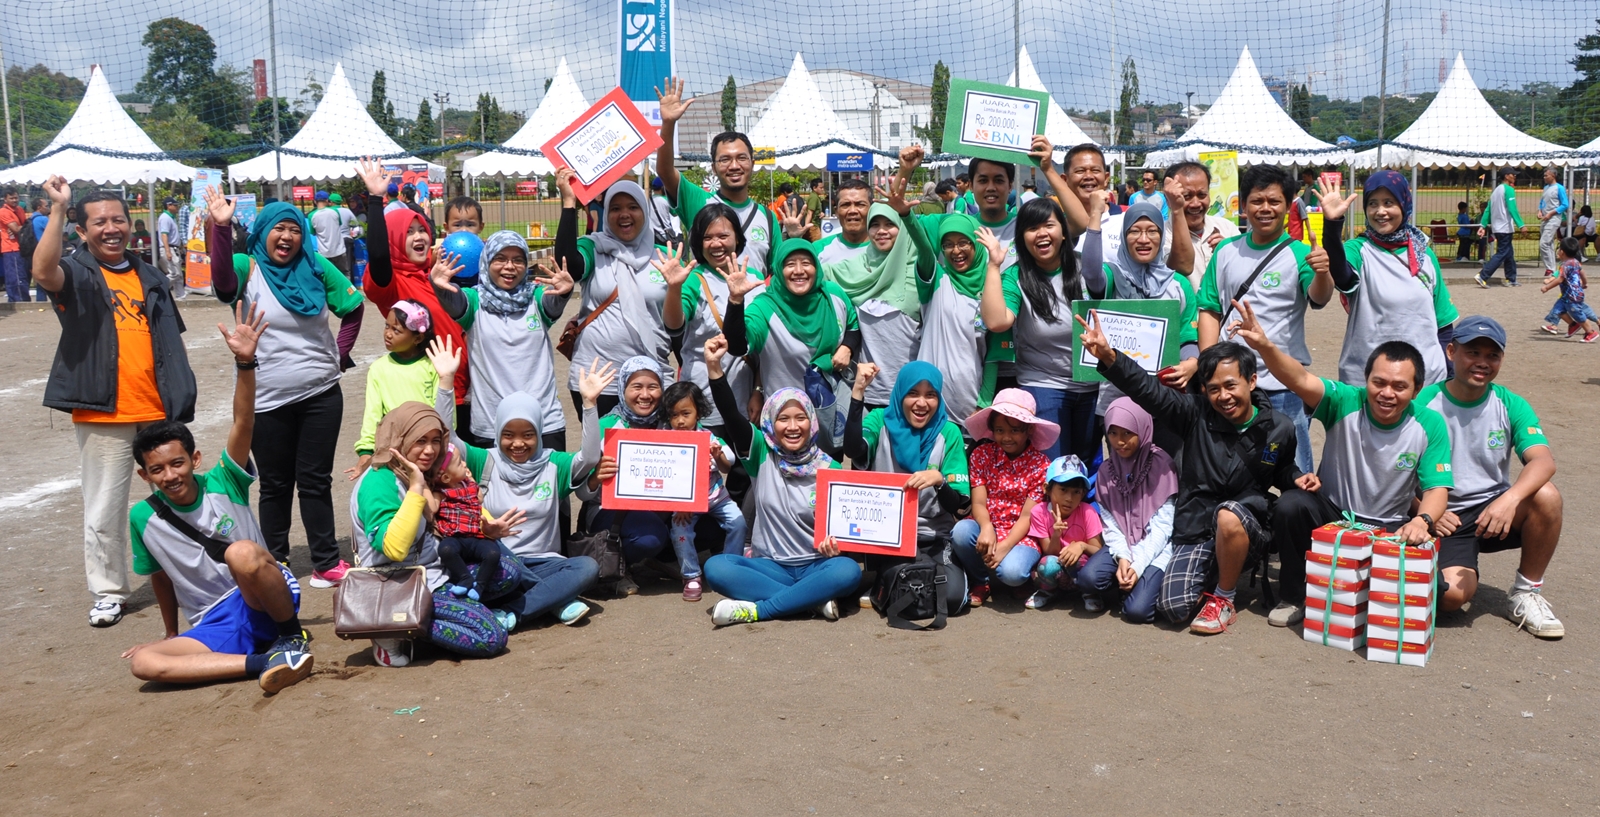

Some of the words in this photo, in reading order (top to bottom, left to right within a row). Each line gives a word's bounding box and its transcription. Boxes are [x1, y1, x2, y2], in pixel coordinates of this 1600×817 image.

[659, 19, 667, 52] Melayani
[980, 99, 1011, 108] JUARA
[975, 114, 986, 127] Rp.
[988, 116, 1019, 130] 200.000,-
[570, 125, 595, 148] JUARA
[992, 131, 1020, 145] BNI
[574, 154, 590, 166] Rp.
[592, 145, 626, 174] mandiri
[1100, 317, 1134, 326] JUARA
[630, 464, 642, 479] Rp.
[644, 466, 676, 480] 500.000,-
[842, 489, 874, 497] JUARA
[841, 505, 852, 522] Rp.
[854, 506, 886, 524] 300.000,-
